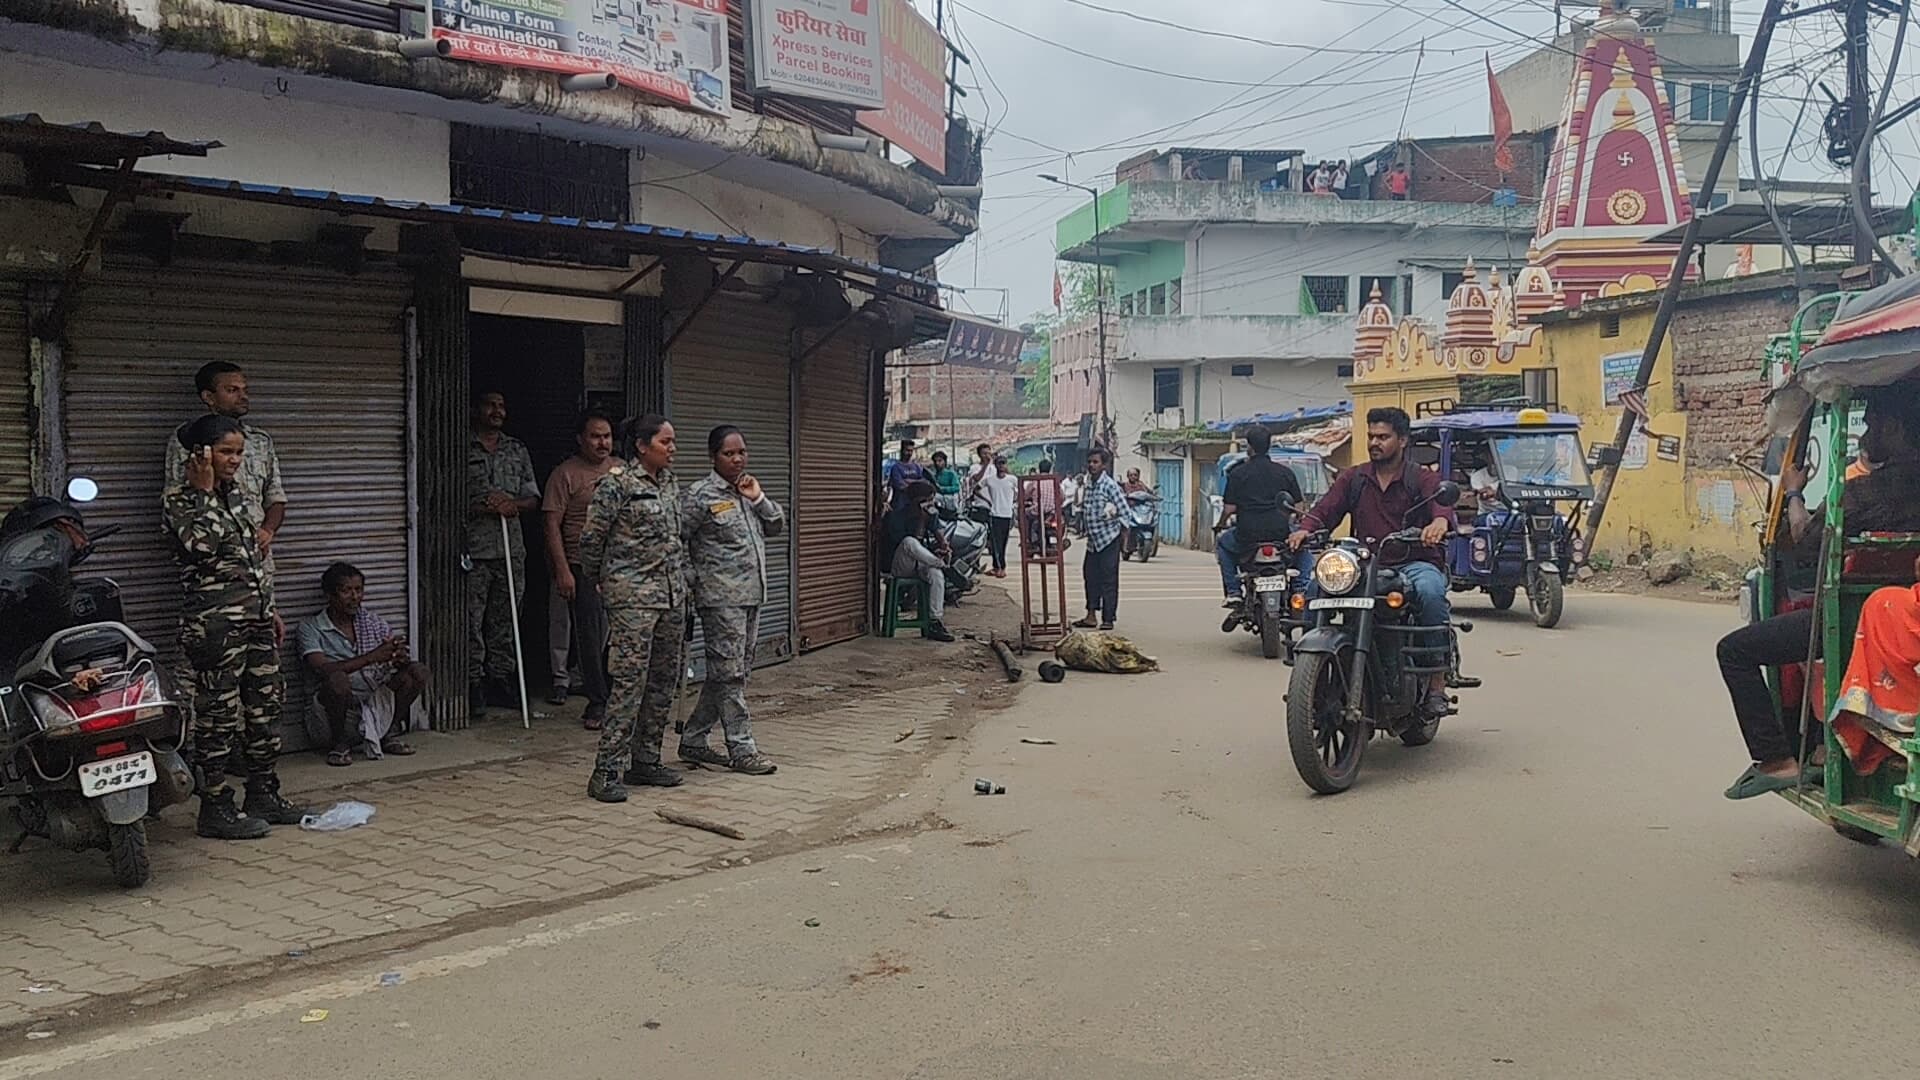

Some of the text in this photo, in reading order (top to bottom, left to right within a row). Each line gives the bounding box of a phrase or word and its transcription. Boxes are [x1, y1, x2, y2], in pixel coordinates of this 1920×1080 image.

[461, 0, 511, 22] Online
[514, 10, 555, 32] Form
[776, 8, 867, 47] कुरियर सेवा
[459, 17, 559, 49] Lamination
[577, 31, 613, 49] Contact
[772, 33, 873, 68] Xpress Services
[777, 51, 871, 86] Parcel Booking
